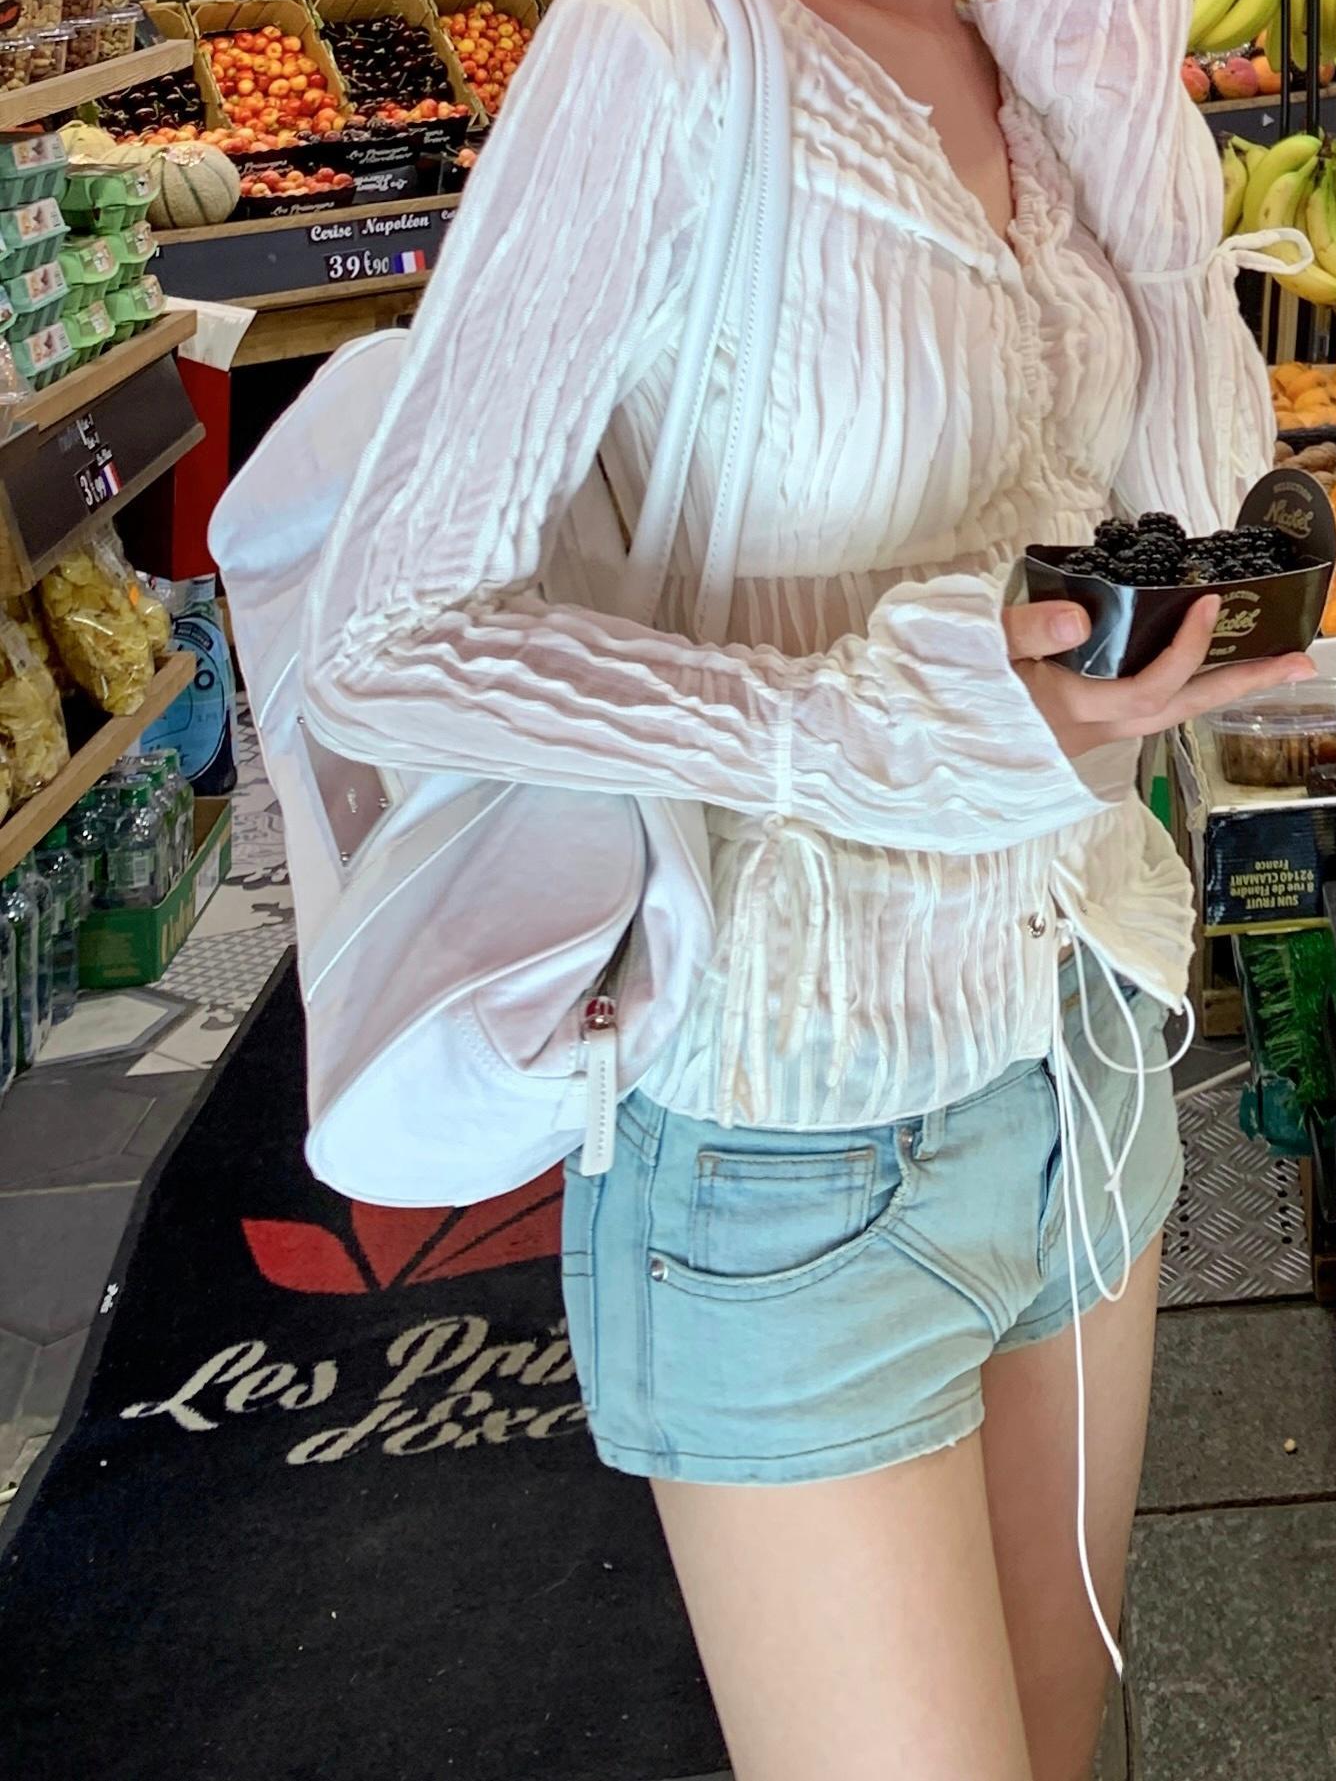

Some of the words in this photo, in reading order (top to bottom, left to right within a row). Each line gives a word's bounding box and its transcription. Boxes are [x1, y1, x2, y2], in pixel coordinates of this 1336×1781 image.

[310, 224, 353, 242] Cerise
[361, 213, 430, 236] Napoléon
[1255, 858, 1289, 871] France
[1230, 872, 1279, 887] CLAMART
[1230, 884, 1271, 899] Flandre
[1271, 884, 1285, 895] de
[1286, 883, 1304, 892] rue
[1245, 897, 1276, 910] FRUIT
[1277, 894, 1299, 908] SUN
[118, 1340, 338, 1432] Les
